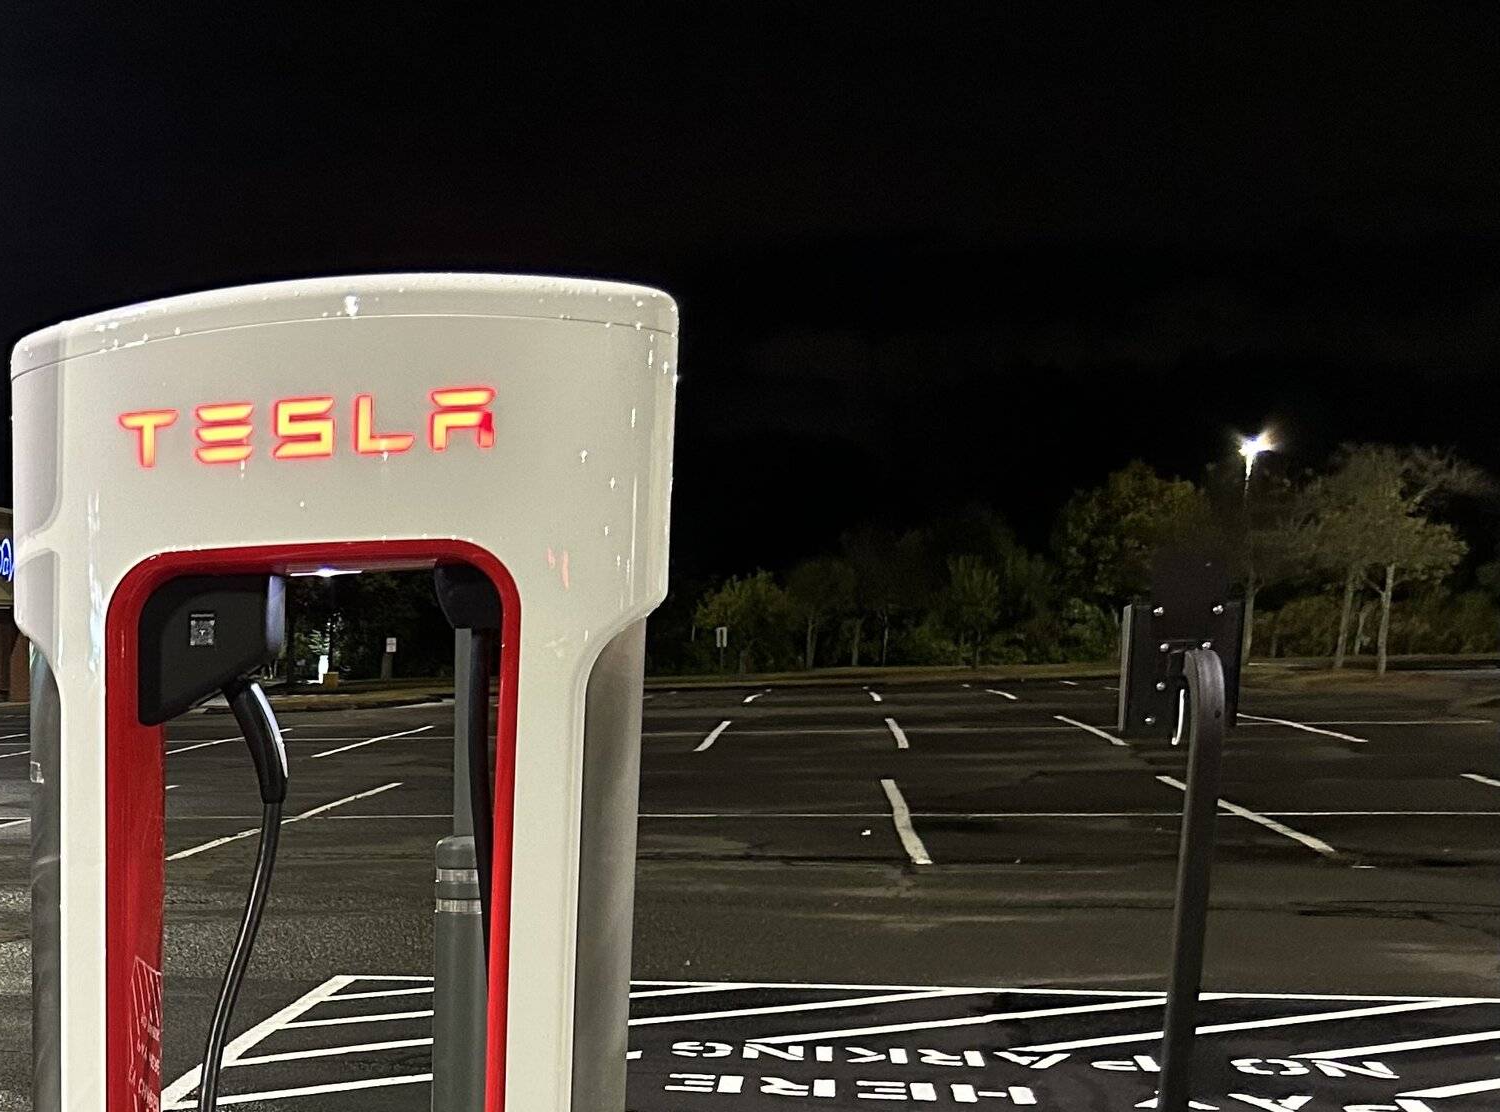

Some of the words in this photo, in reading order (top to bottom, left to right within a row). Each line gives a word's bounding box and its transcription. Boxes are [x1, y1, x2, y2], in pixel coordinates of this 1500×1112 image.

[118, 386, 496, 468] TESLA
[671, 1041, 1162, 1072] PARKING
[1230, 1058, 1400, 1079] NO
[665, 1073, 1037, 1105] HERE
